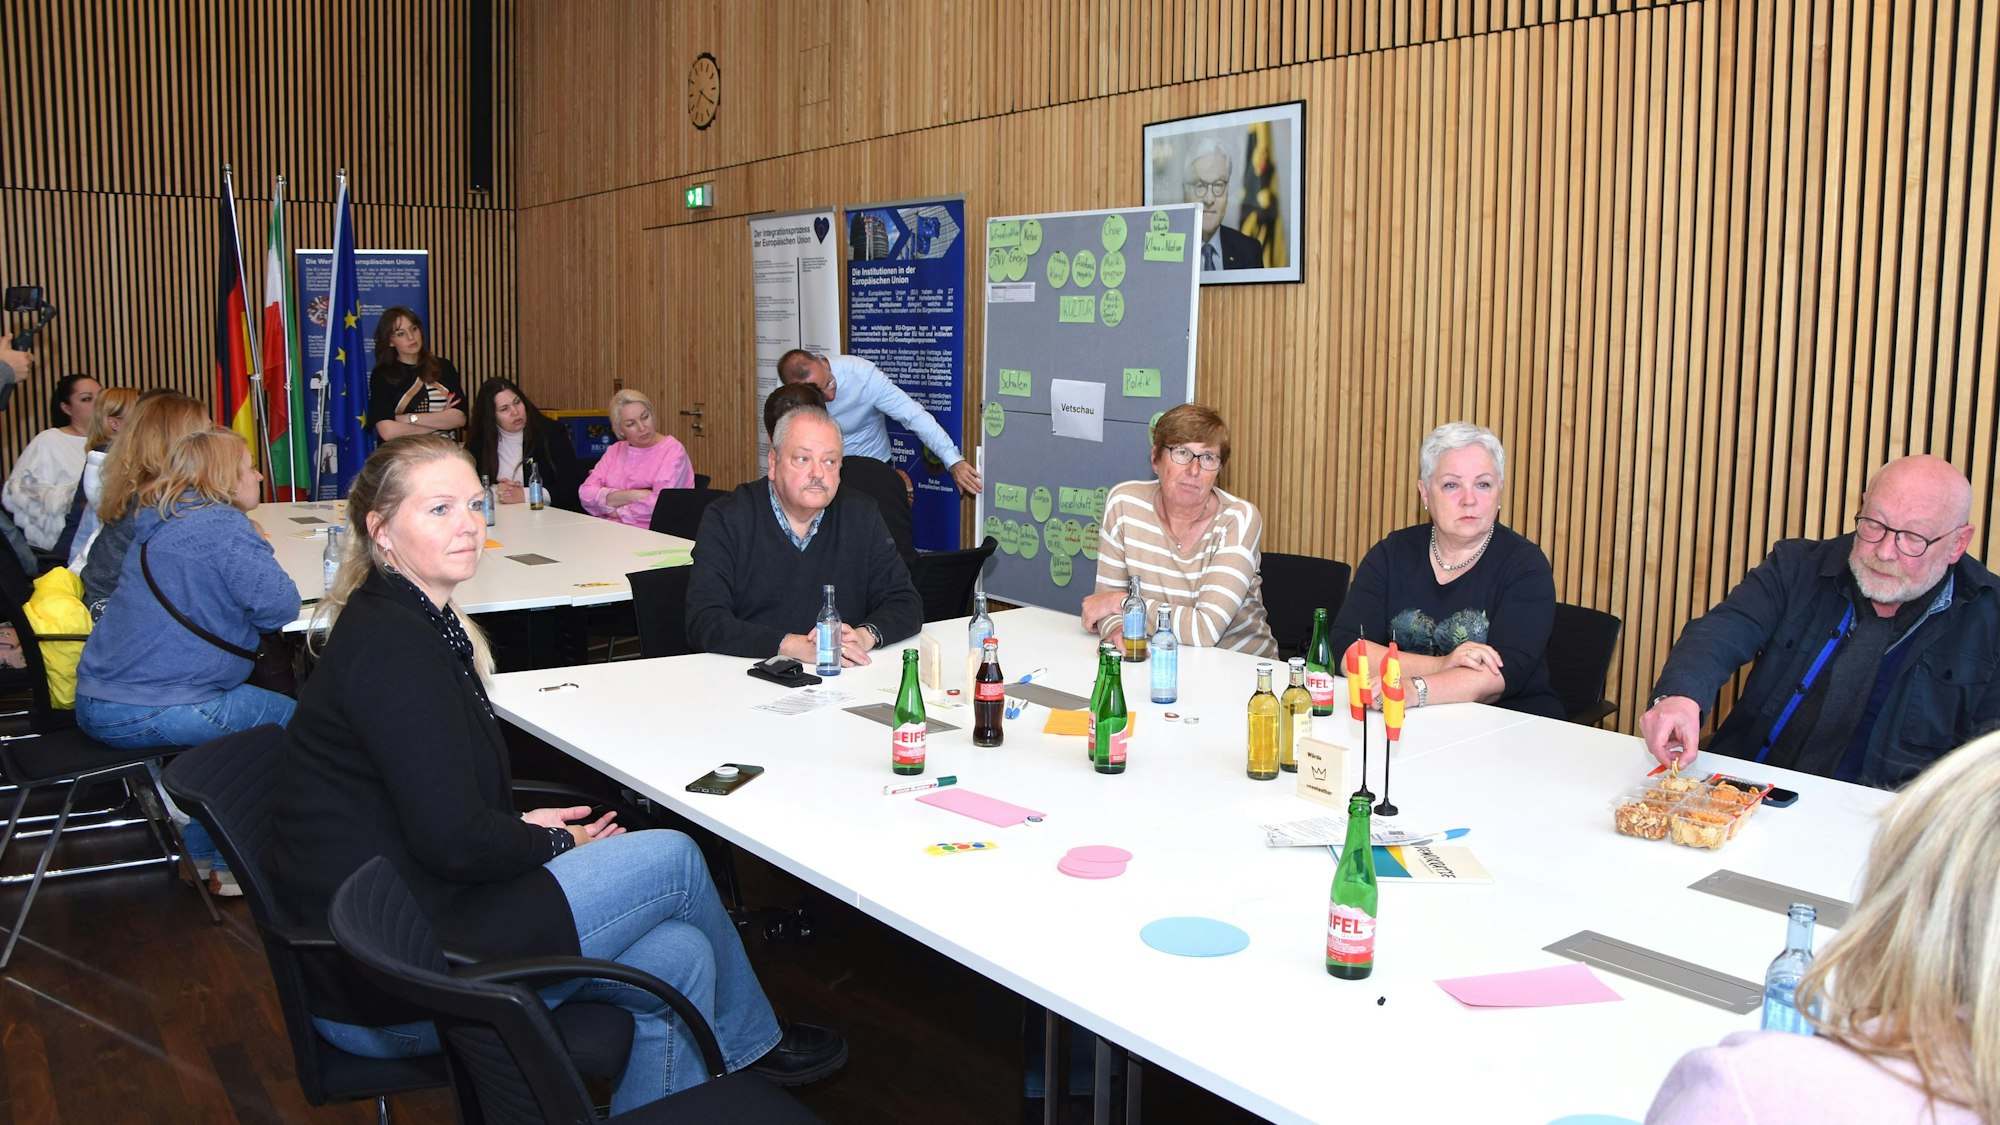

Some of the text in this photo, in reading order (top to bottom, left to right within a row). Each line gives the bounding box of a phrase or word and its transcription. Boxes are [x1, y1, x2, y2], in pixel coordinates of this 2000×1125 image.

[763, 227, 810, 238] Integrationsprozess
[763, 238, 796, 247] Europäischen
[797, 236, 811, 244] Union
[852, 266, 915, 276] Die Institutionen in der
[852, 276, 909, 286] Europäischen Union
[1064, 298, 1093, 318] KULTUR
[1001, 371, 1027, 390] Schulen
[1126, 373, 1151, 390] Politik
[1061, 403, 1094, 414] Vetschau
[998, 486, 1018, 504] Sport
[902, 731, 925, 743] EIFE
[1328, 913, 1363, 934] IFEL
